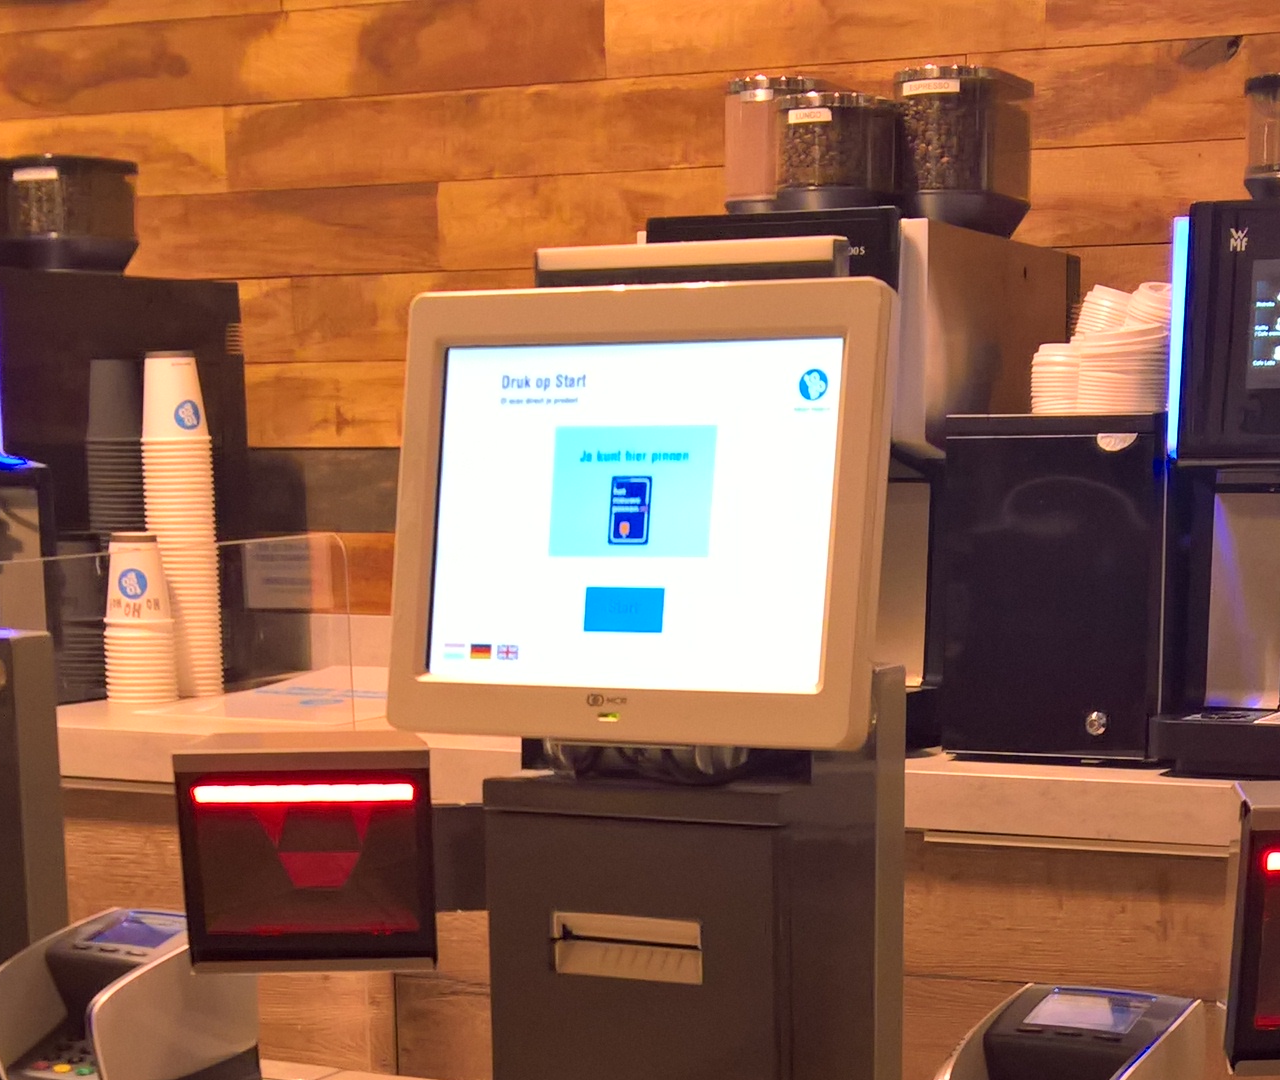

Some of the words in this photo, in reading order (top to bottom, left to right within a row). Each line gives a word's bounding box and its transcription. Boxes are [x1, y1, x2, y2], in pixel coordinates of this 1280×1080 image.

[909, 81, 950, 92] ESPRESSO
[1230, 226, 1248, 251] WMF
[502, 375, 531, 390] Druk
[535, 377, 551, 392] op
[555, 374, 586, 388] Start
